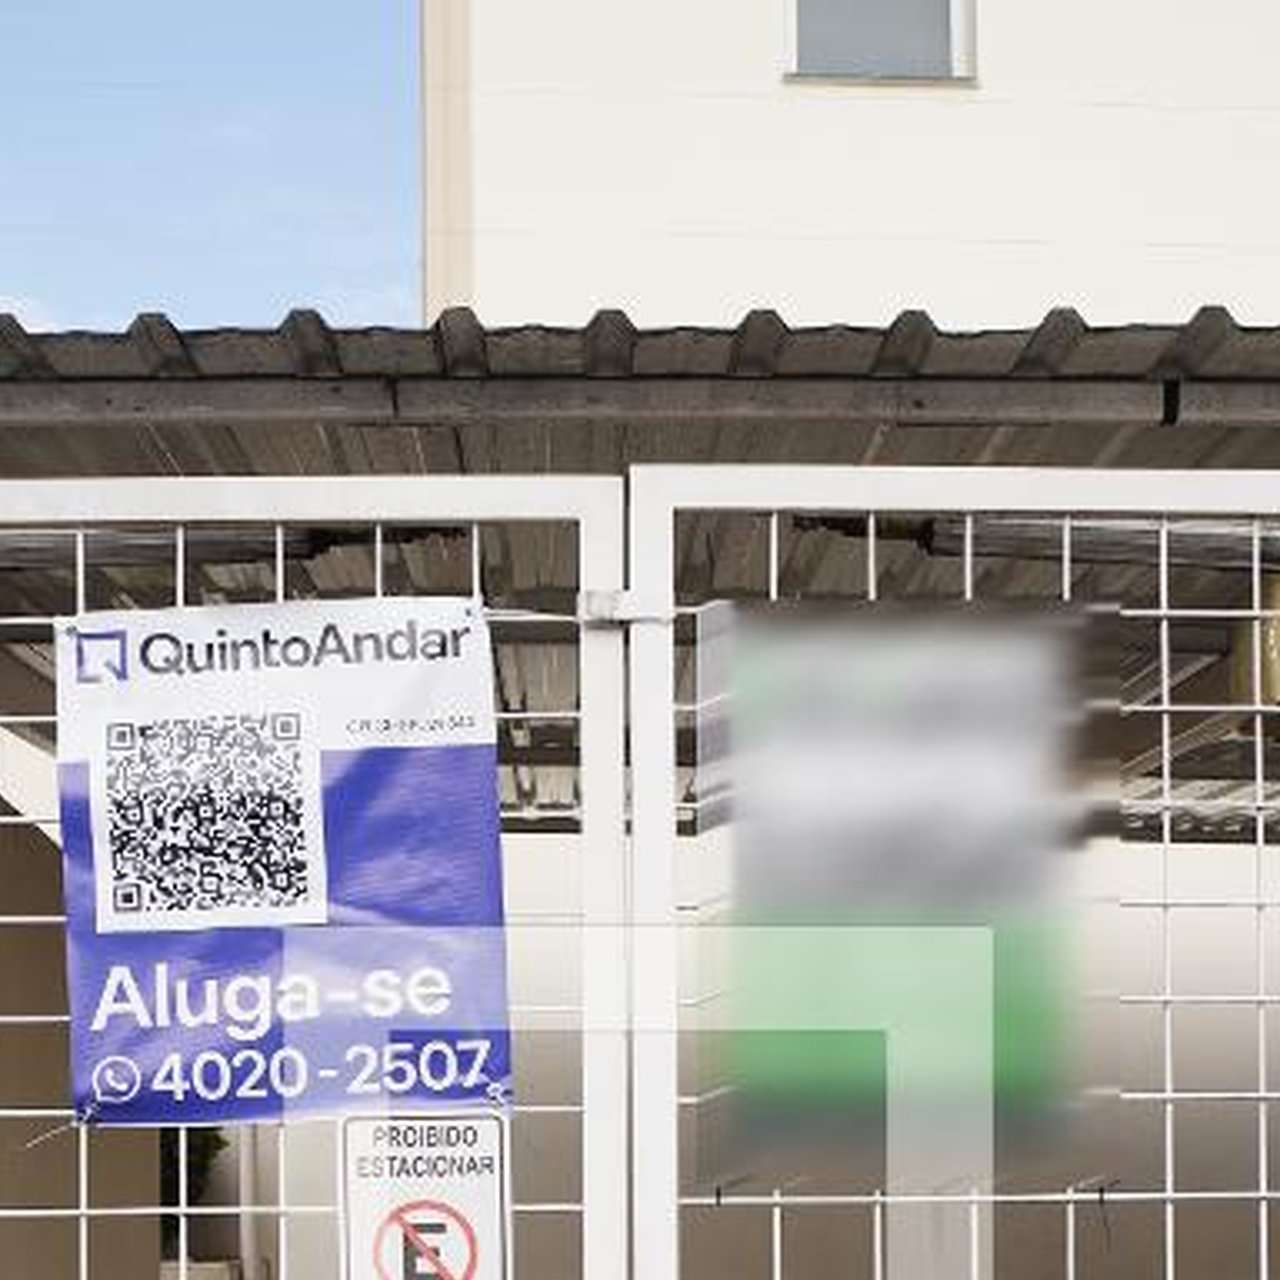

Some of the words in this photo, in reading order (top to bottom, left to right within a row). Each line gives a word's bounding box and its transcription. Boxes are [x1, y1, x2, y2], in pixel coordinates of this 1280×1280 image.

[140, 619, 472, 677] QuintoAndar
[90, 962, 452, 1041] Aluga-se
[151, 1039, 492, 1102] 4020-2507
[372, 1125, 478, 1148] PROIBIDO
[356, 1155, 495, 1178] ESTACIONAR
